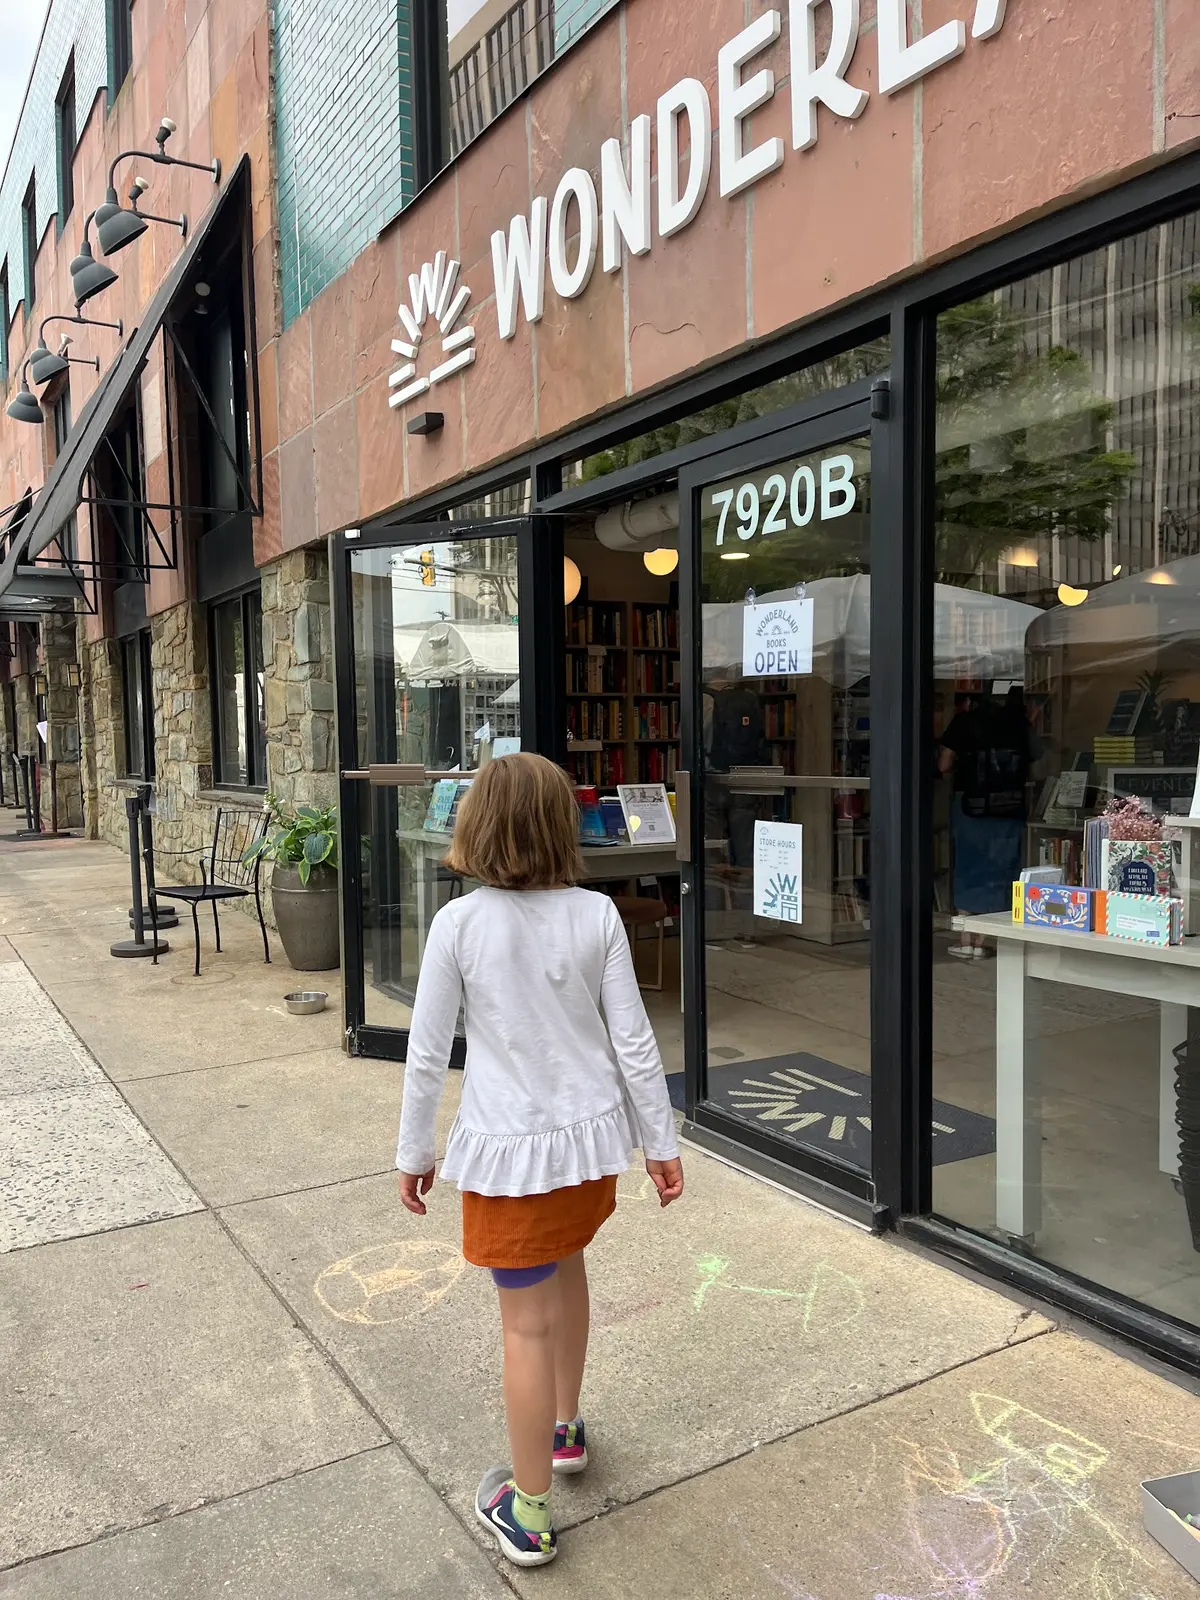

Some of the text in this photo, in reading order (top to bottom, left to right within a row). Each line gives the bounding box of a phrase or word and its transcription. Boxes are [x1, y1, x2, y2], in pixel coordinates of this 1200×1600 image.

[490, 0, 1007, 340] WONDERL
[711, 454, 856, 546] 7920B
[756, 609, 799, 637] WONDERLAND
[766, 638, 787, 648] BOOKS
[754, 650, 798, 673] OPEN
[759, 838, 796, 849] STORE HOURS
